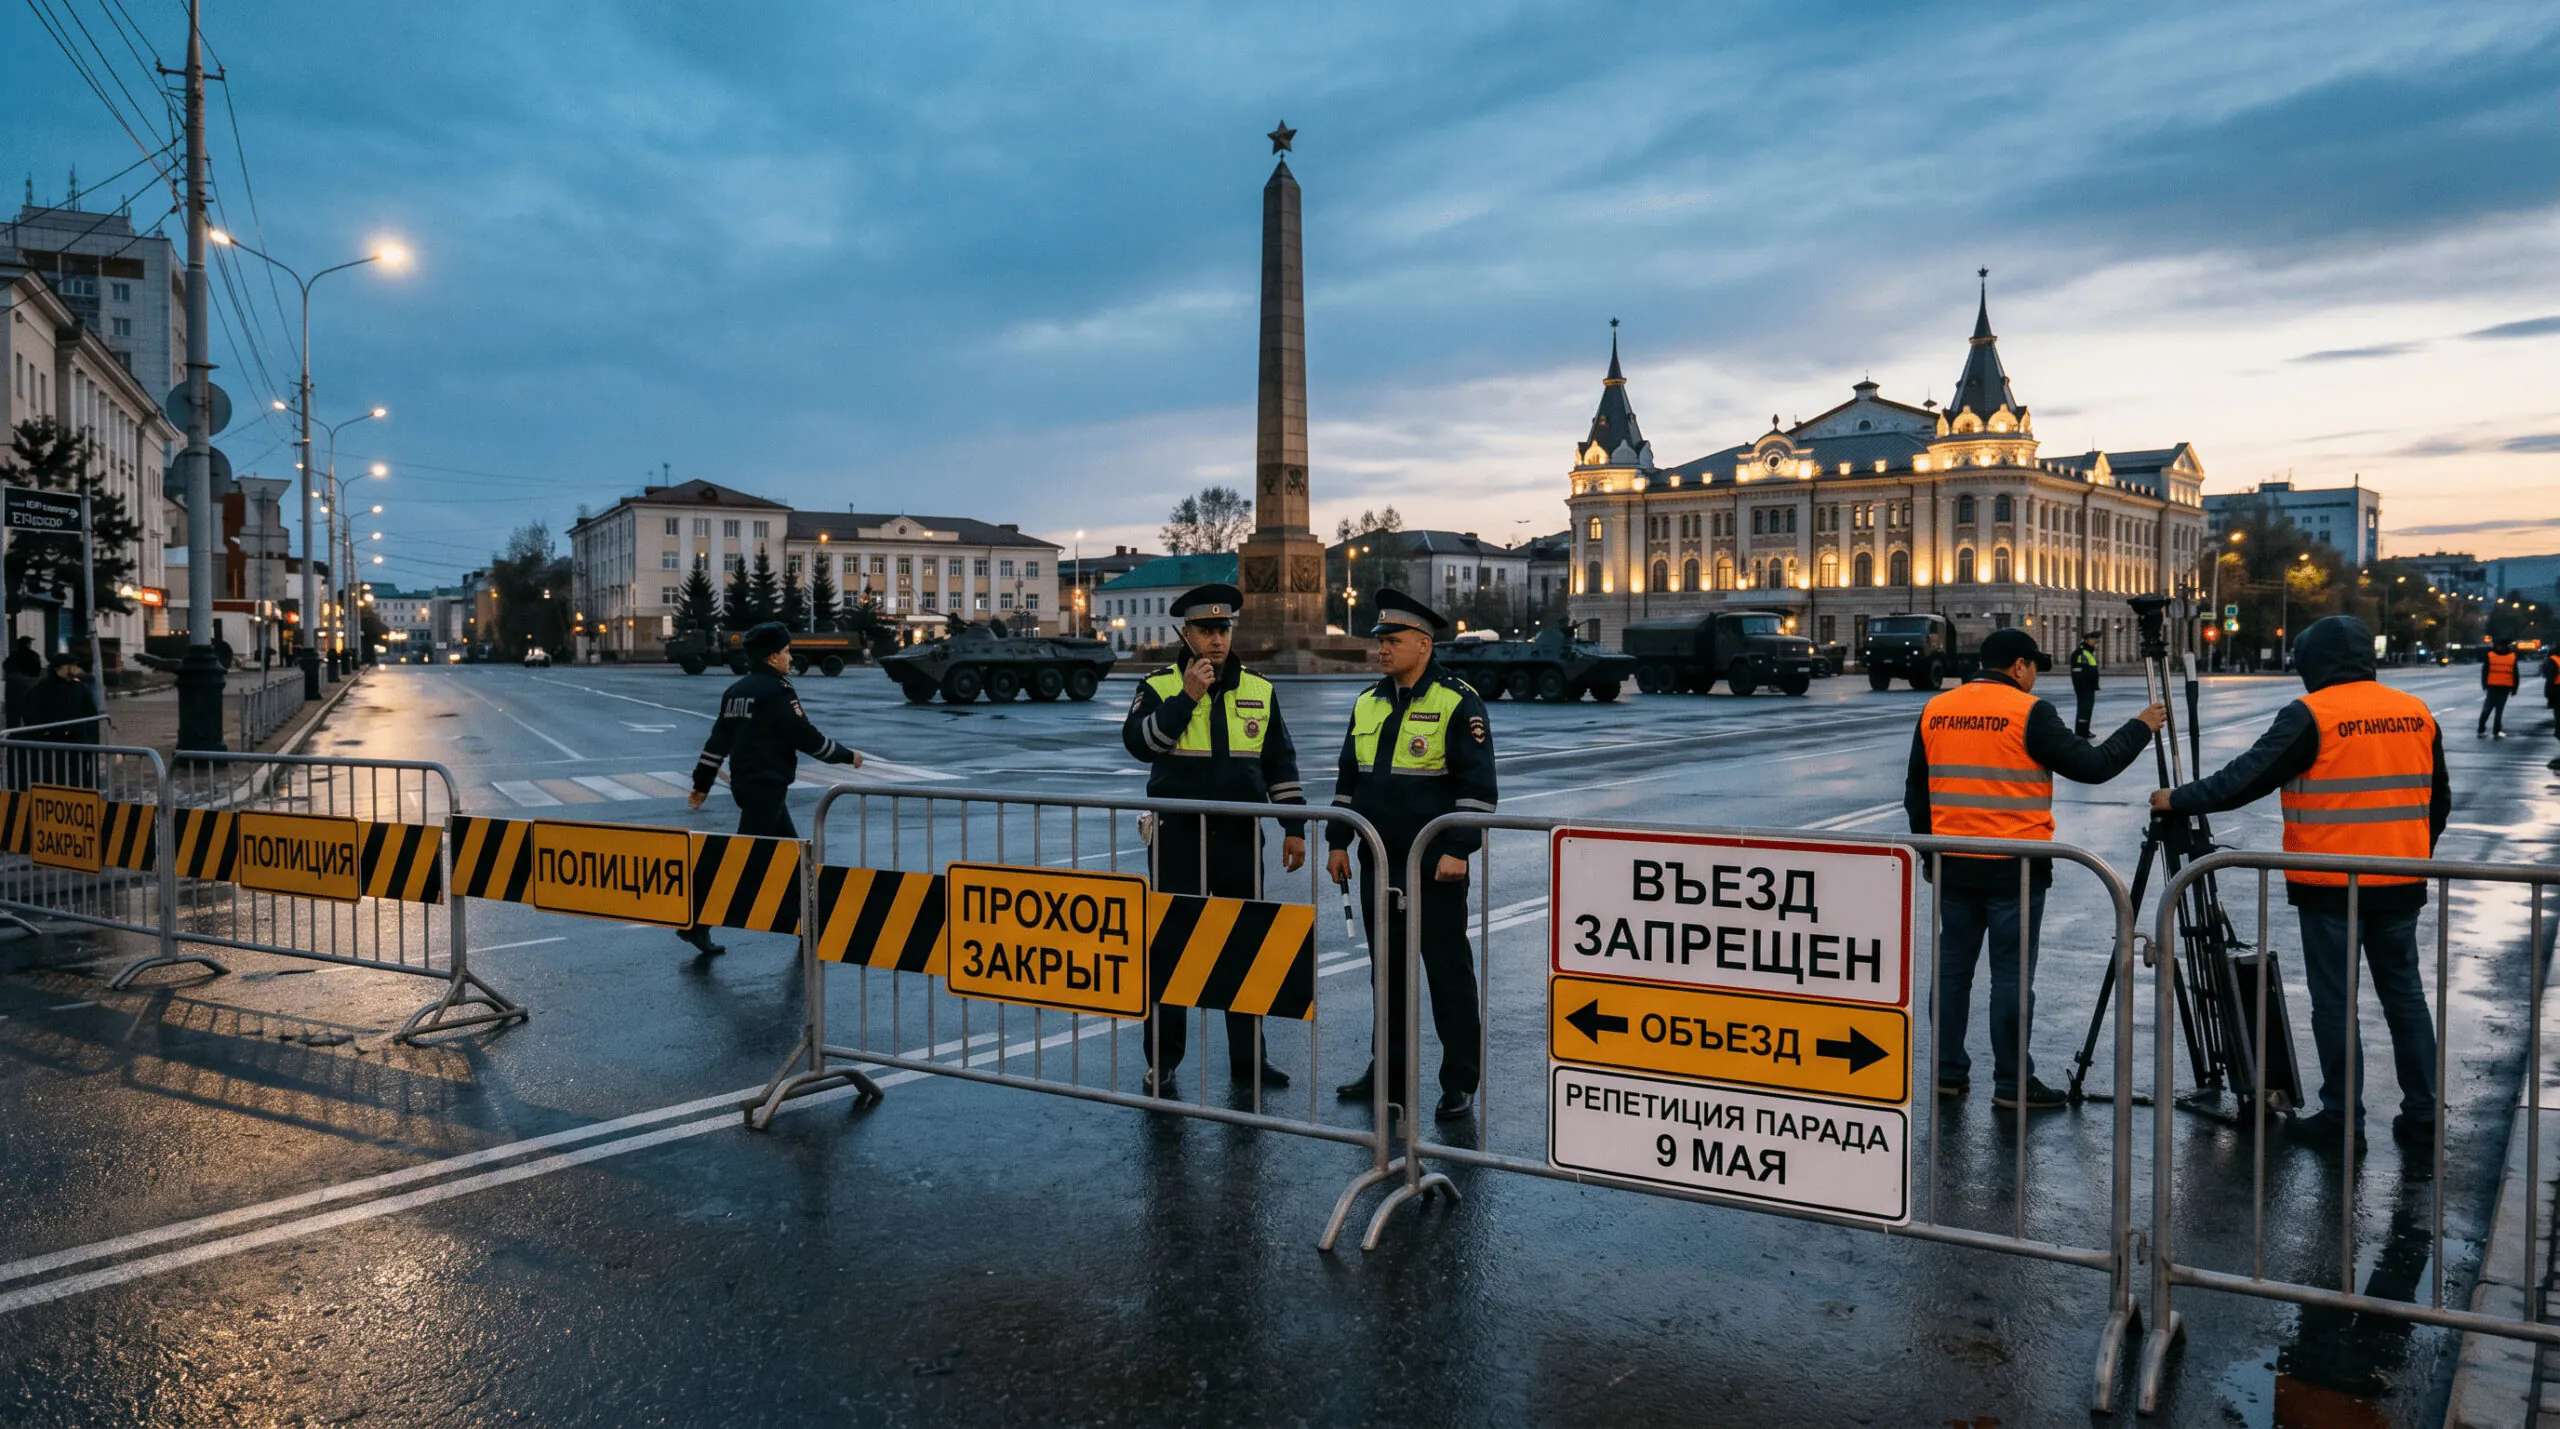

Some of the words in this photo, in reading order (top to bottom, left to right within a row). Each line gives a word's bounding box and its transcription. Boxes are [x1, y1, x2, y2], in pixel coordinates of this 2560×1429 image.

[1929, 715, 2009, 732] ОРГАНИЗАТОР
[2337, 716, 2425, 738] ОРГАНИЗАТОР
[35, 798, 96, 831] ПРОХОД
[37, 828, 96, 861] ЗАКРЫТ
[243, 834, 355, 880] ПОЛИЦИЯ
[538, 847, 684, 900] ПОЛИЦИЯ
[1632, 858, 1818, 926] ВЪЕЗД
[963, 884, 1129, 946] ПРОХОД
[962, 939, 1129, 995] ЗАКРЫТ
[1573, 912, 1882, 985] ЗАПРЕЩЕН
[1640, 1012, 1802, 1066] ОБЪЕЗД
[1565, 1082, 1745, 1132] РЕПЕТИЦИЯ
[1756, 1108, 1891, 1155] ПАРАДА
[1656, 1133, 1678, 1167] 9
[1691, 1138, 1787, 1186] МАЯ
